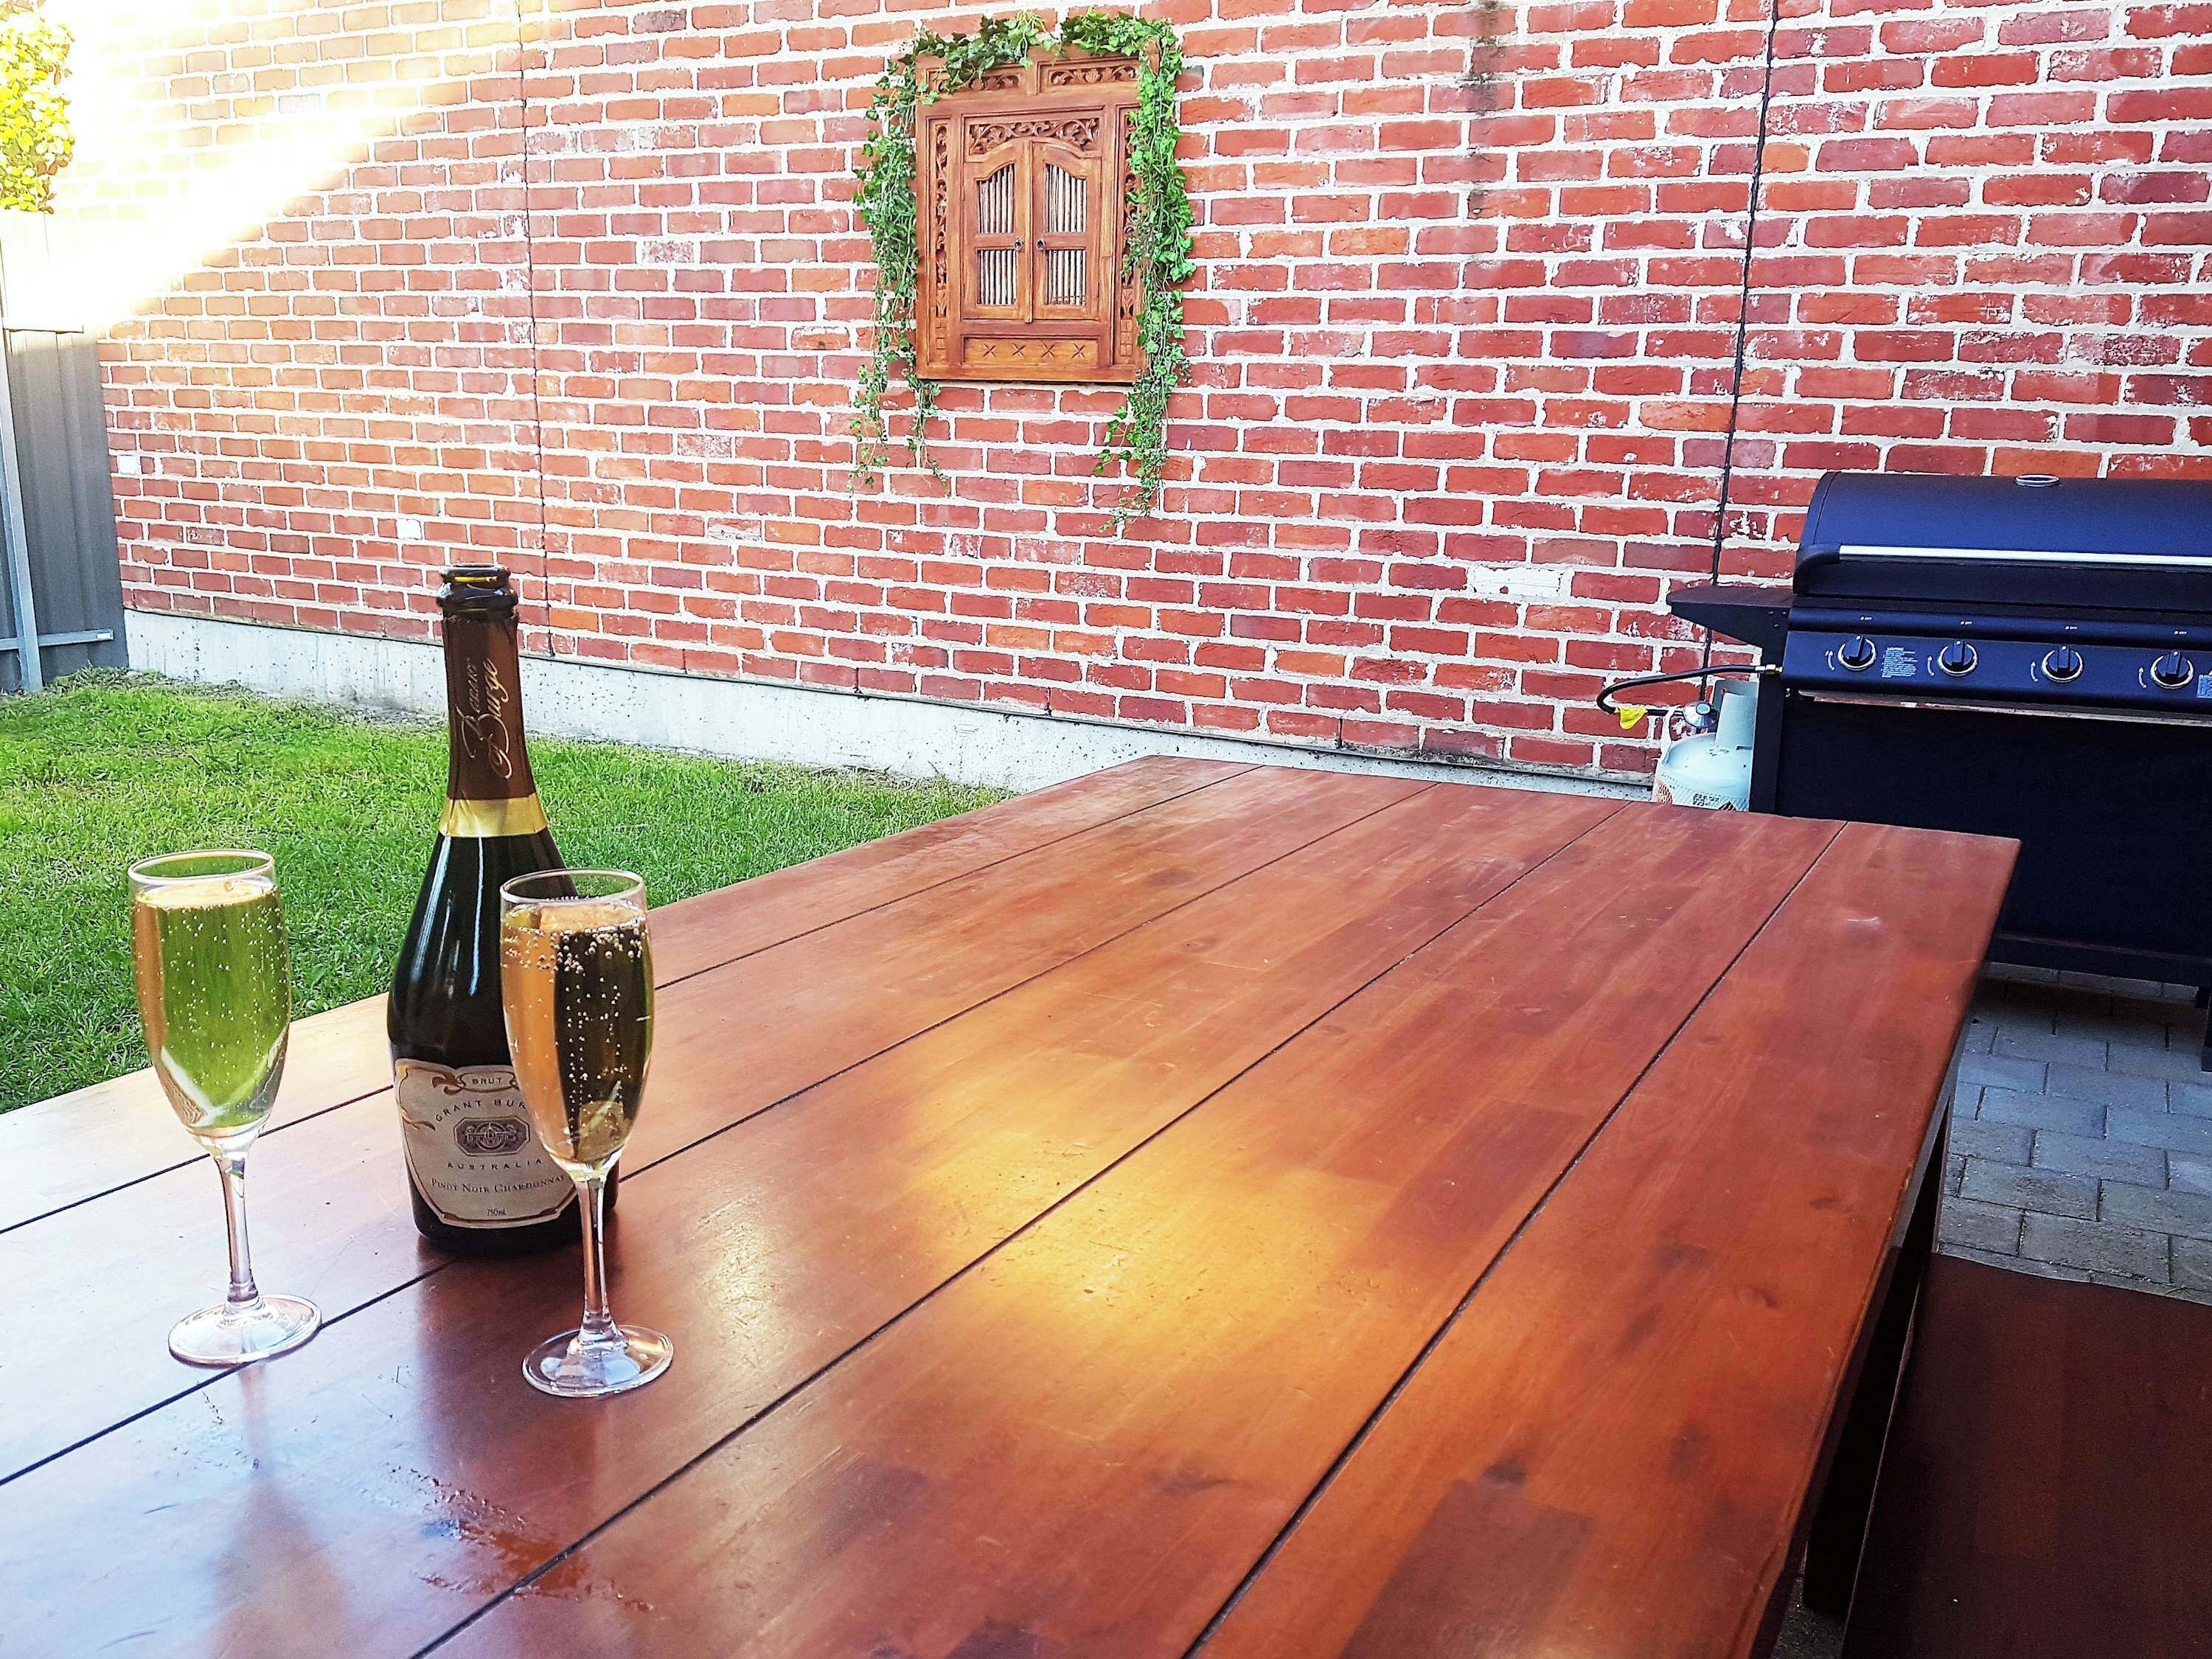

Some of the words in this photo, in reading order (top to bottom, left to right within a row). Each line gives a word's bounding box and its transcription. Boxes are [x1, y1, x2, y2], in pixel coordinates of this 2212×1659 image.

[472, 1077, 502, 1085] BRUT
[435, 1099, 481, 1121] GRANT
[494, 1099, 526, 1110] BUR
[446, 1158, 543, 1170] AUSTRALIA
[431, 1178, 458, 1191] PINOT
[462, 1184, 490, 1193] NOIR
